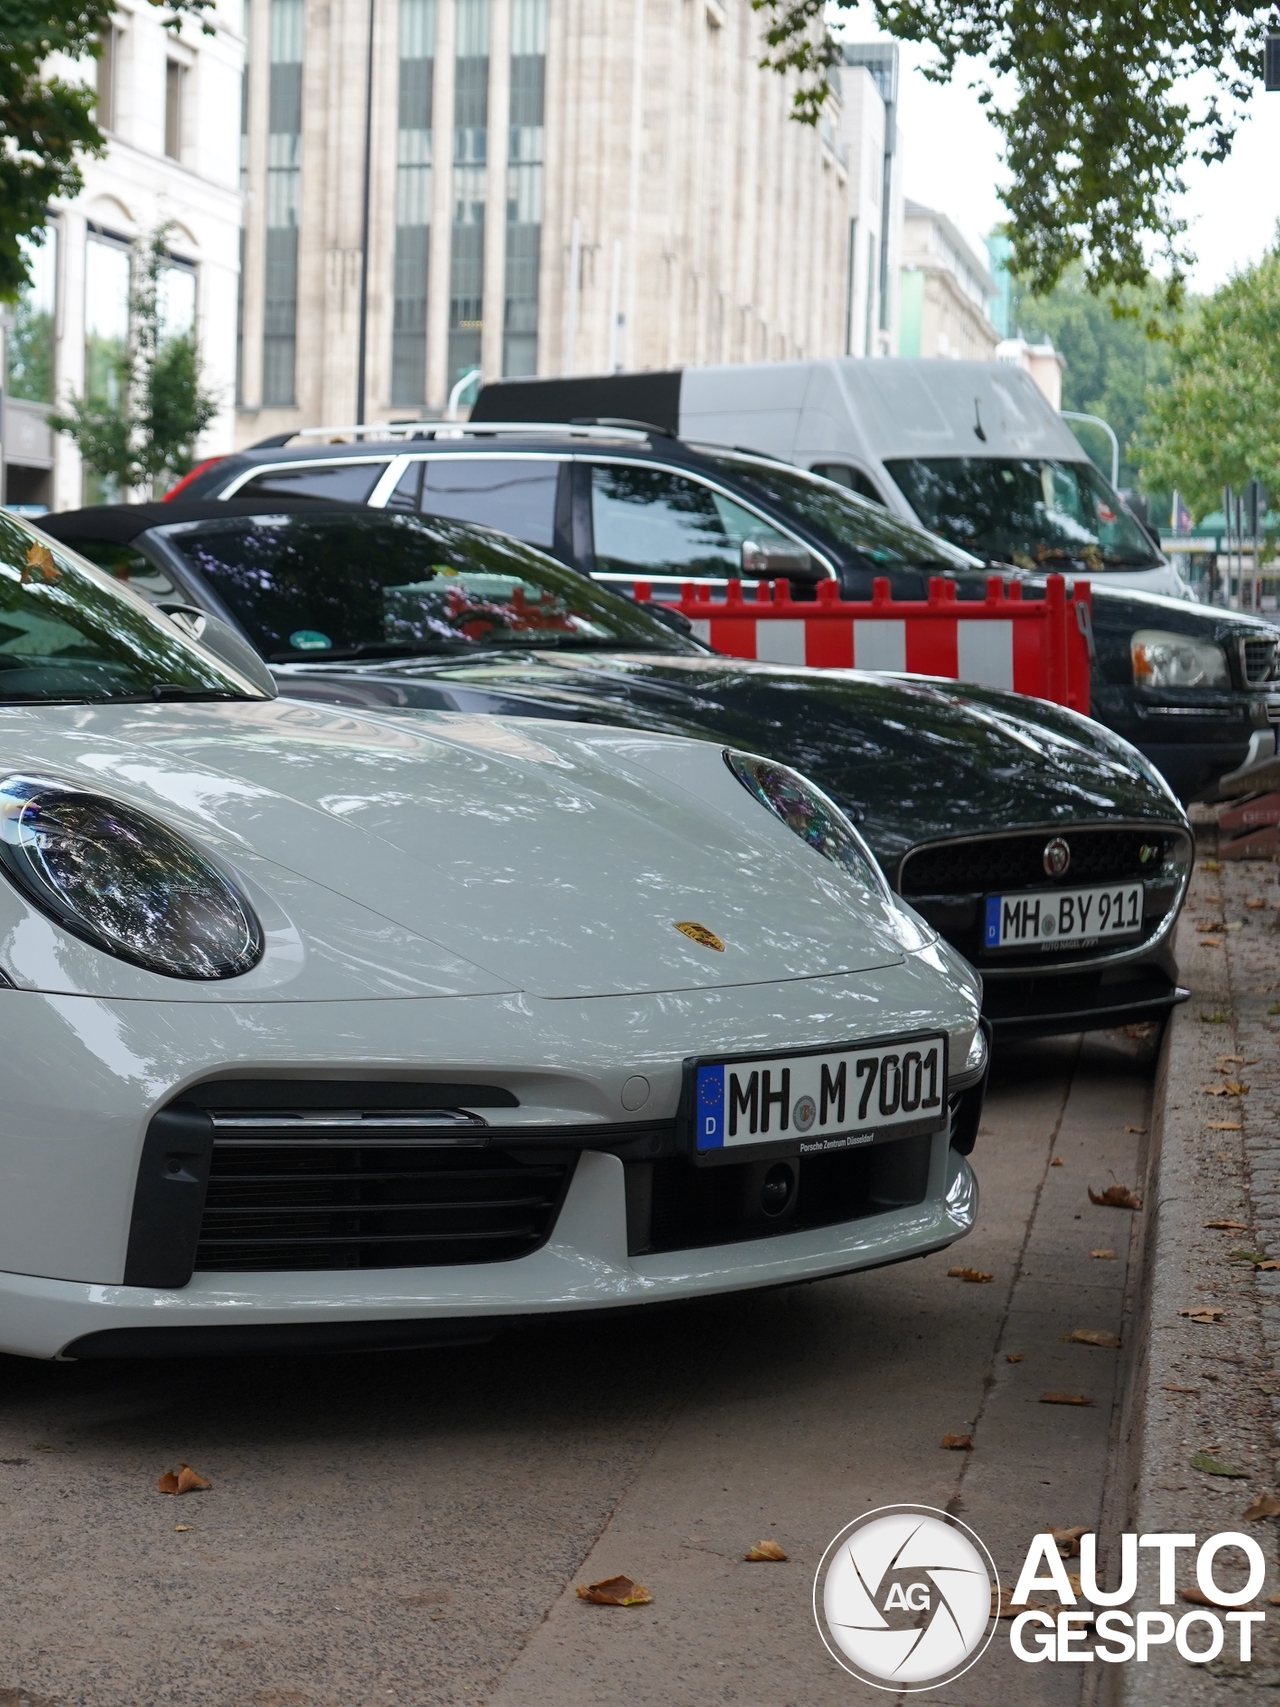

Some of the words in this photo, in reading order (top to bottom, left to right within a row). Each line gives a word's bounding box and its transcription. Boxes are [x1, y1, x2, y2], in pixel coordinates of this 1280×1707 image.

[1003, 899, 1040, 940] MH
[1058, 894, 1093, 934] BY
[1098, 890, 1140, 932] 911
[1041, 941, 1059, 952] AUTO
[705, 1116, 717, 1135] D
[728, 1067, 791, 1137] MH
[819, 1061, 847, 1126] M
[856, 1047, 941, 1120] 7001
[799, 1140, 823, 1153] Porsche
[823, 1137, 847, 1149] Zentrum
[846, 1133, 875, 1145] Düsseldorf
